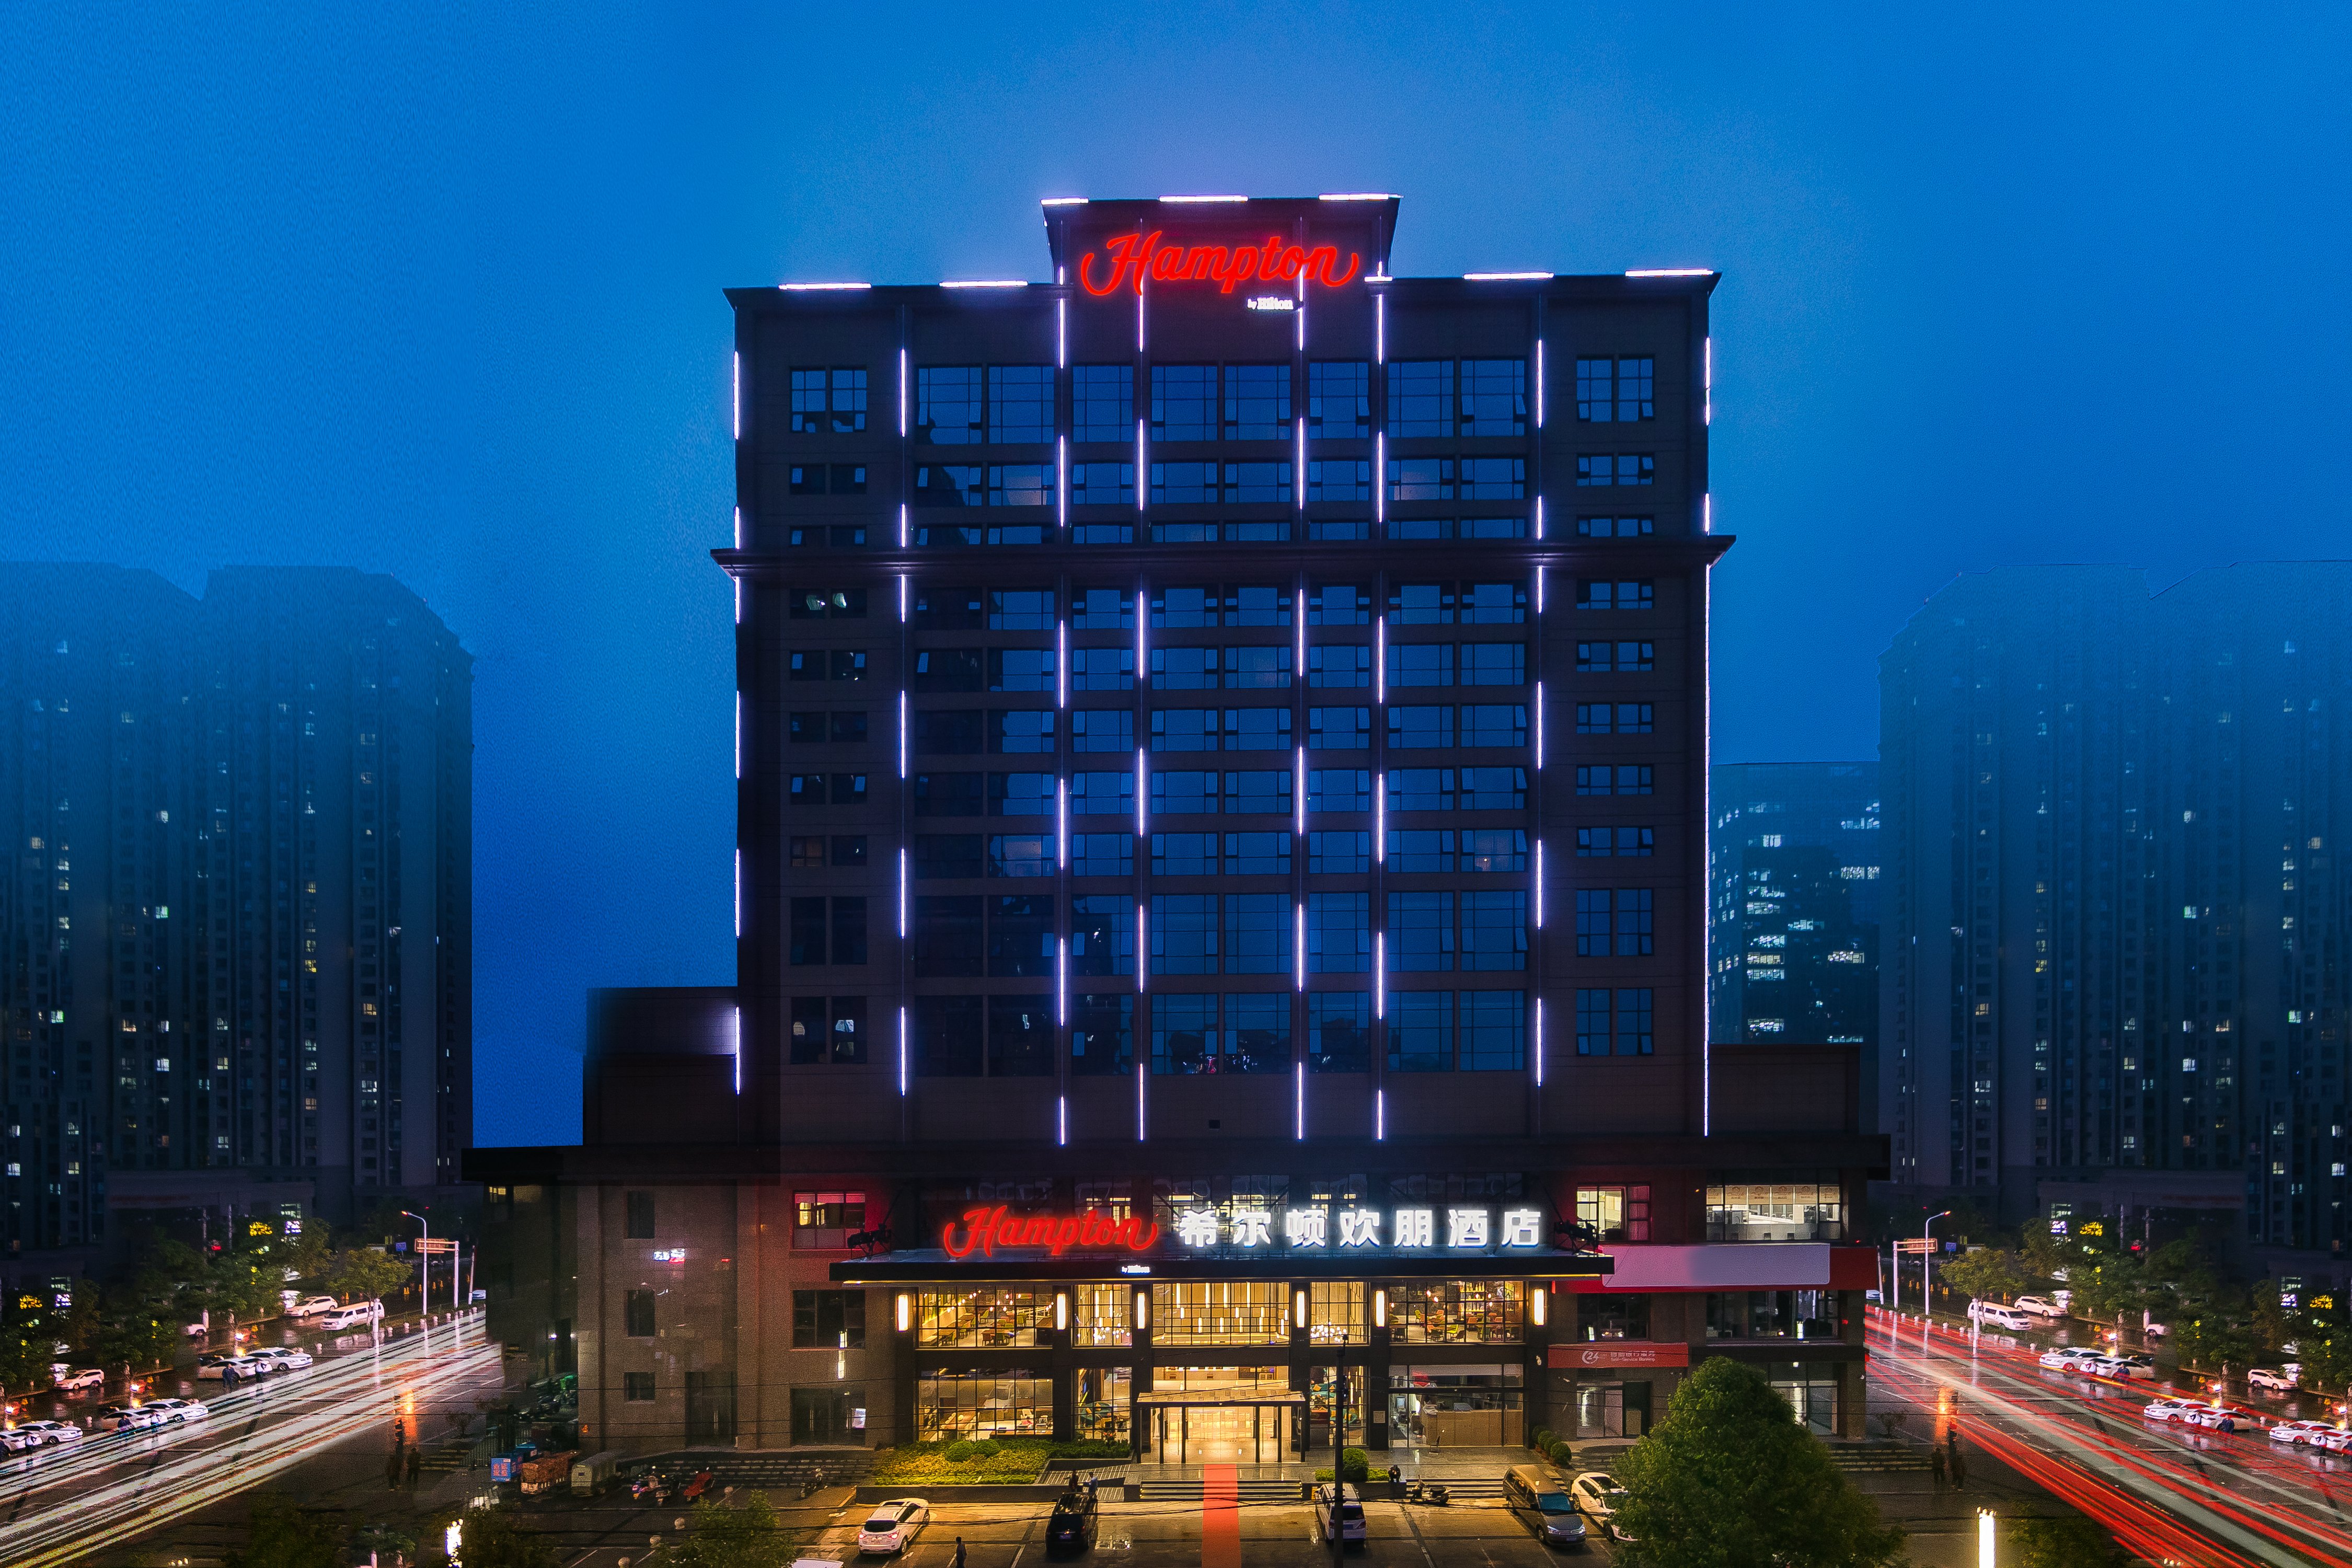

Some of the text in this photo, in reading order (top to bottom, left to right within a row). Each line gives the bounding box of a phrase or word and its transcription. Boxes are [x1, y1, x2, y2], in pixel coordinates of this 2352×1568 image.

[1080, 230, 1359, 296] Hampton
[1247, 298, 1257, 309] by
[943, 1205, 1158, 1257] Hampton
[1179, 1204, 1541, 1248] 希尔顿欢朋酒店
